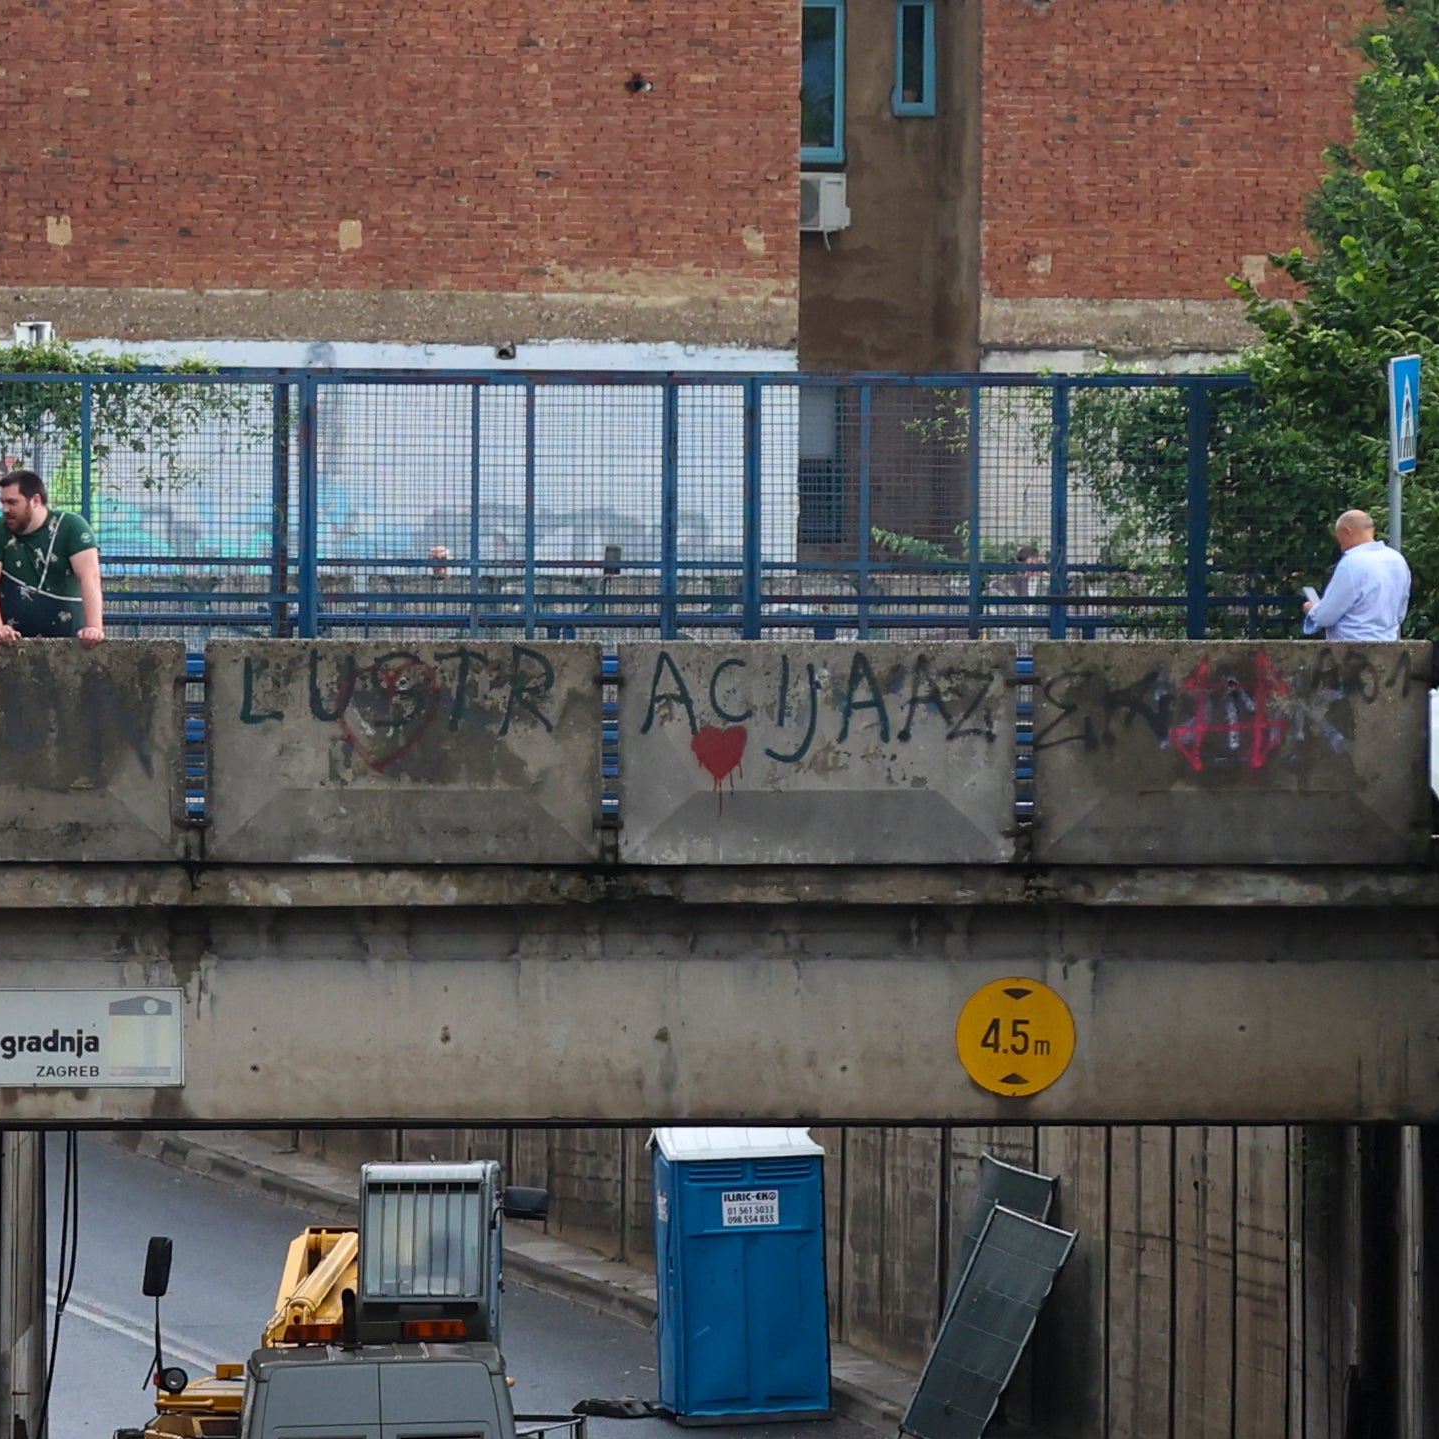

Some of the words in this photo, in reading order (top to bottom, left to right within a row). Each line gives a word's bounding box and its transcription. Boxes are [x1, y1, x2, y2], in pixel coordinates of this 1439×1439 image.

[980, 1018, 1030, 1055] 4.5
[1034, 1039, 1051, 1055] m
[36, 1065, 99, 1077] ZAGREB
[727, 1207, 737, 1215] 01
